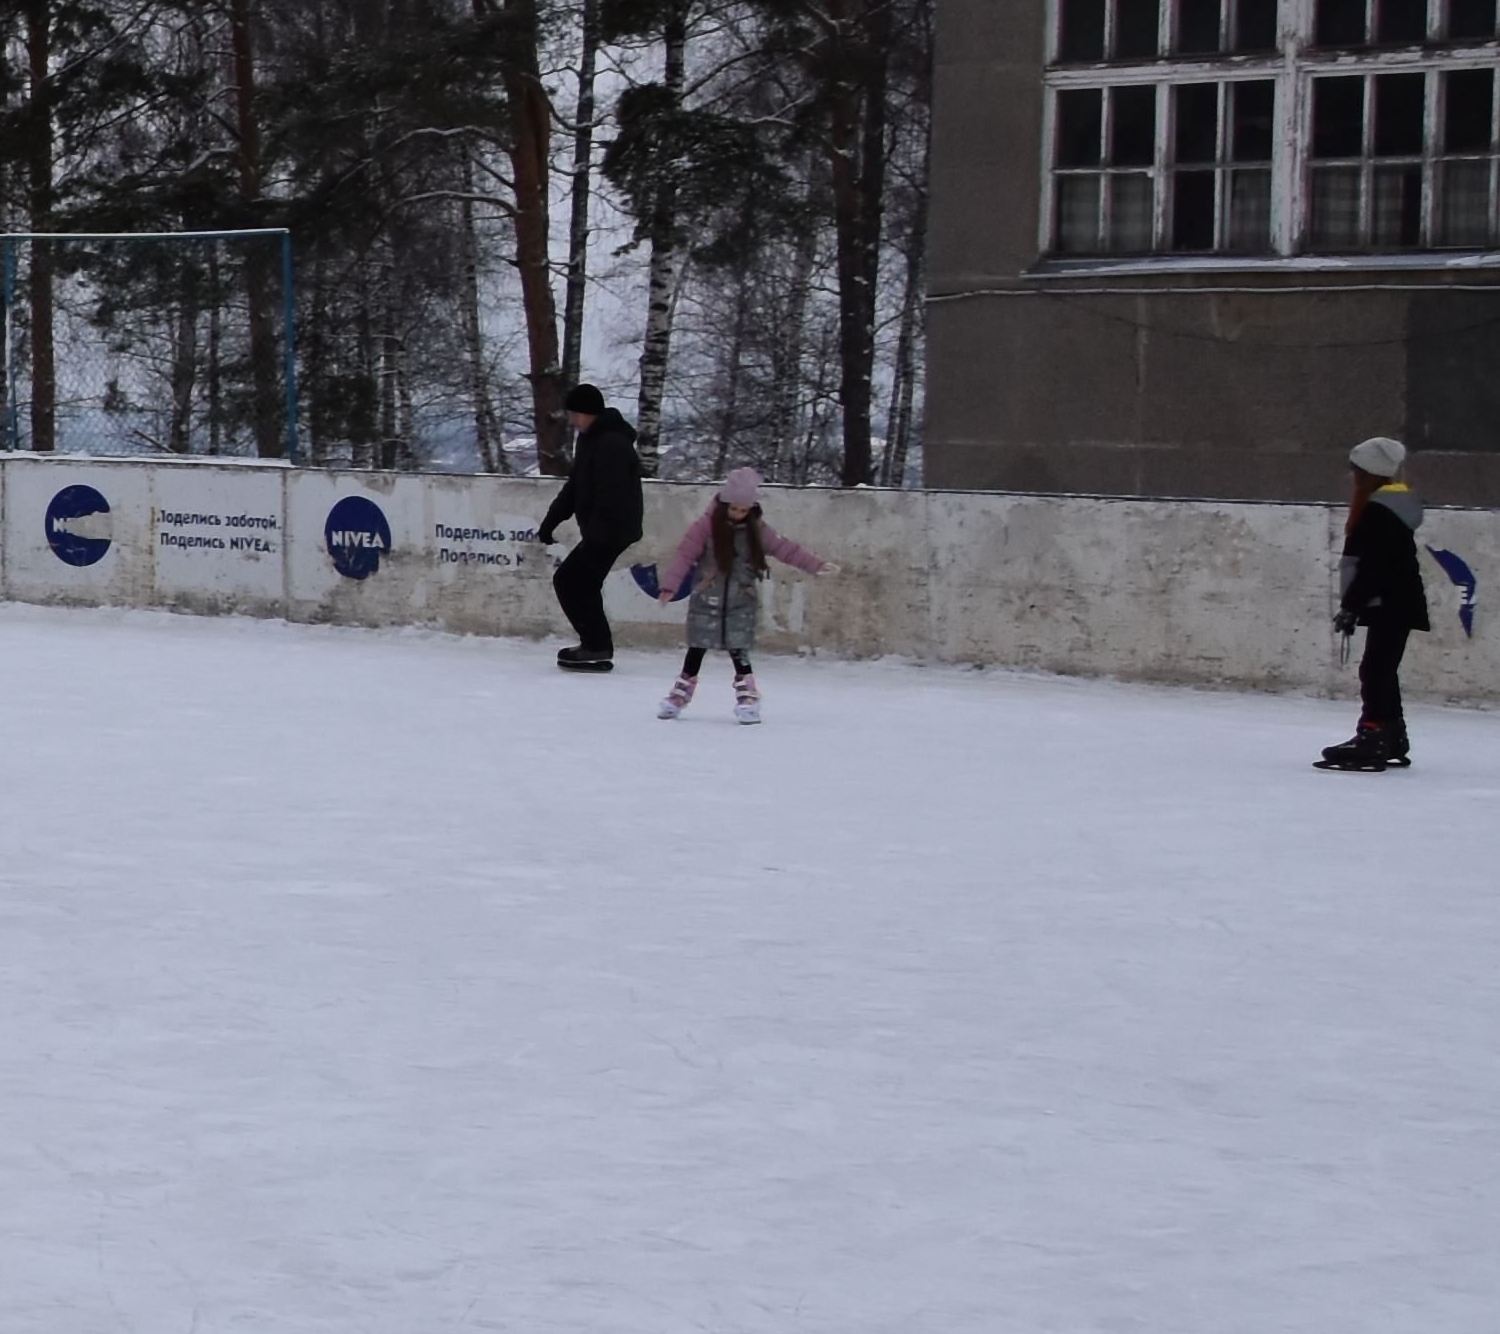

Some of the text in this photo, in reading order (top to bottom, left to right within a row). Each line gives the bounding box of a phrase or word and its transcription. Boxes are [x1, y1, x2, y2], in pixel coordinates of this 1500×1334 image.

[225, 515, 282, 530] заботой.
[331, 530, 385, 548] NIVEA
[435, 524, 505, 542] Поделись
[160, 532, 276, 553] Поделись NIVEA.
